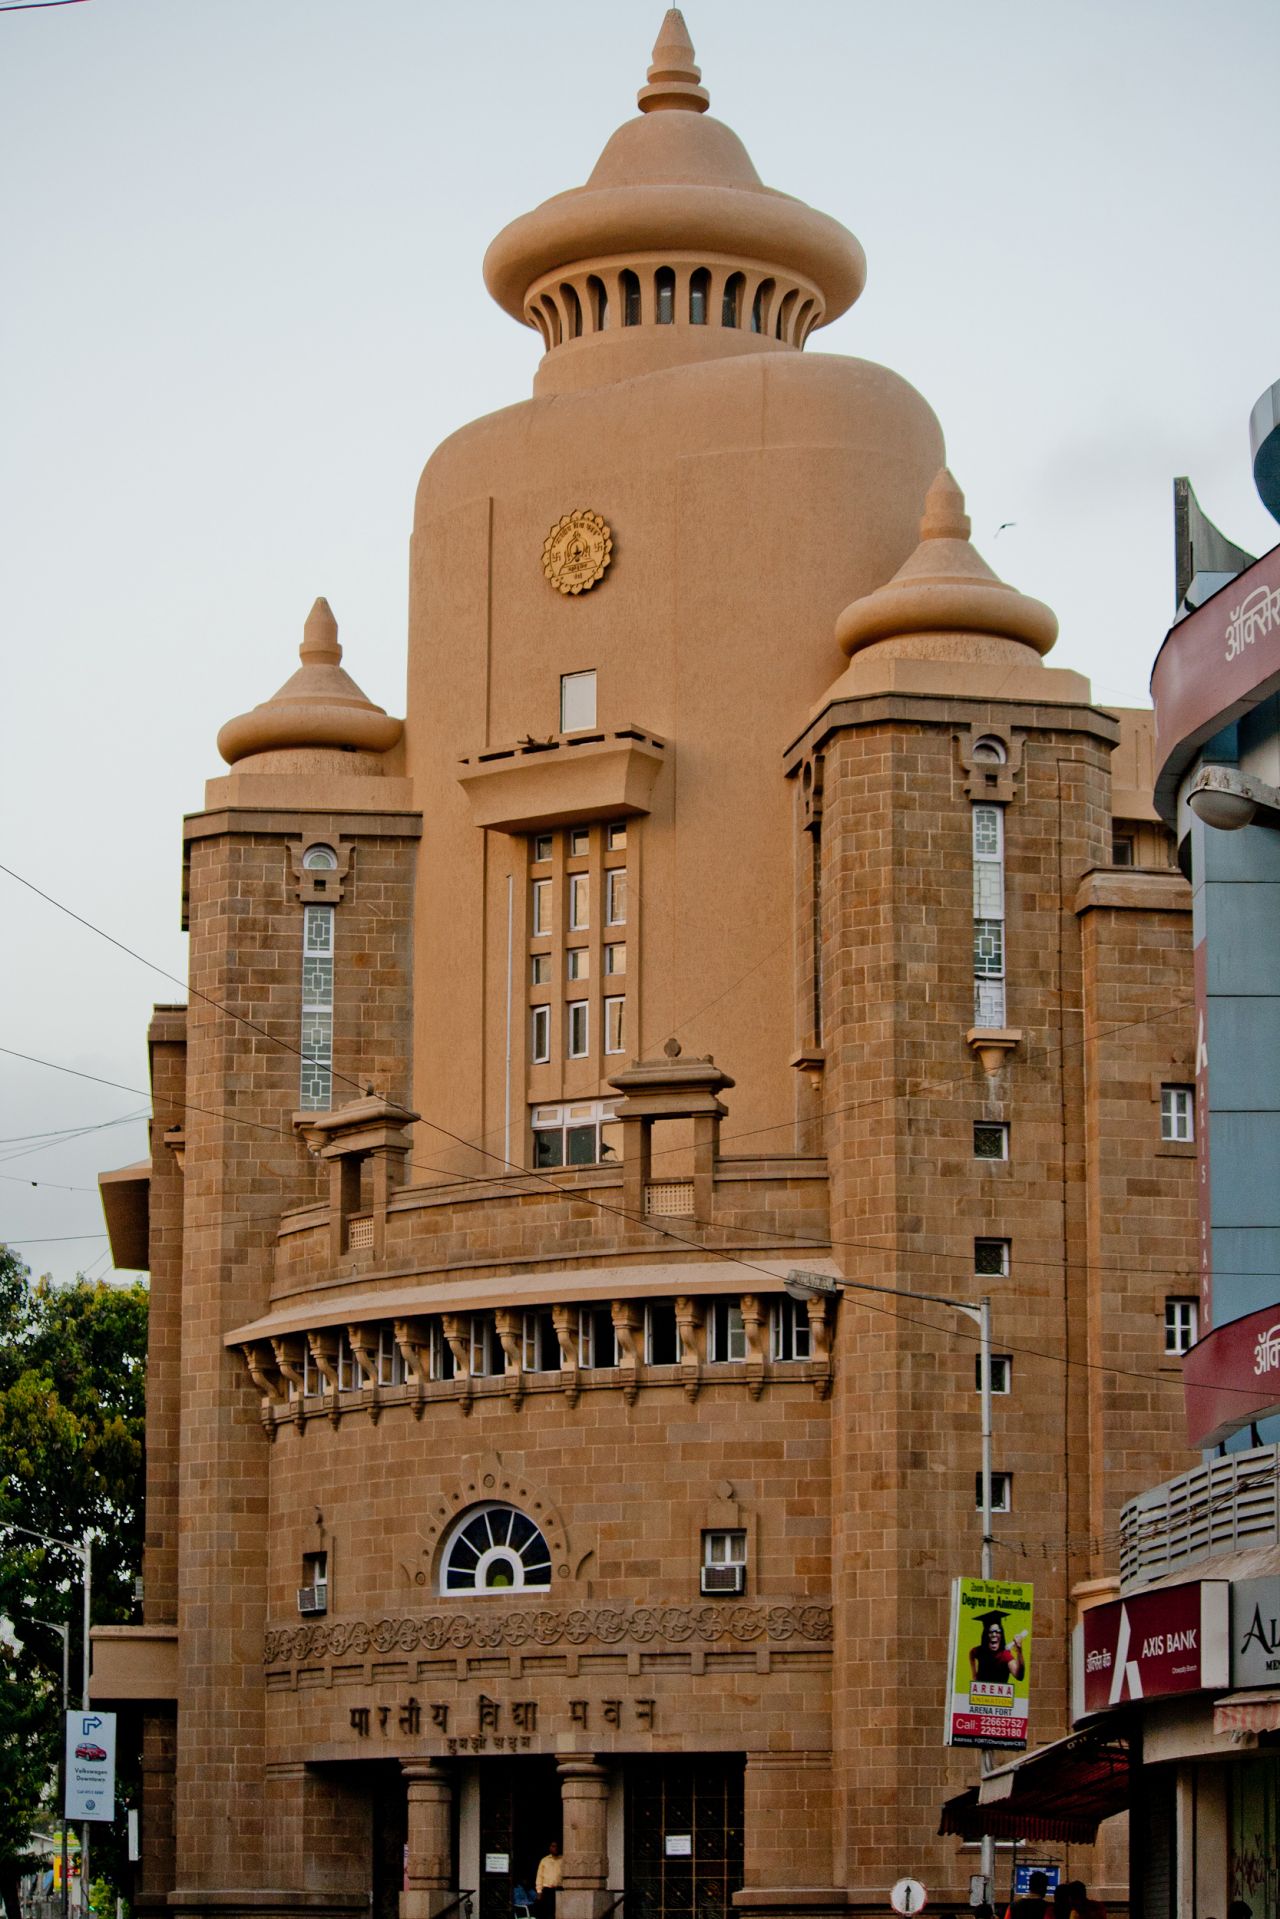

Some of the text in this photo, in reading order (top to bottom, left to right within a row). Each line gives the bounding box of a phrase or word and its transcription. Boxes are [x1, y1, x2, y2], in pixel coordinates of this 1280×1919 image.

[962, 1593, 1031, 1611] Degree in Animation
[1142, 1629, 1197, 1659] AXIS BANK
[972, 1684, 1012, 1695] ARENA
[969, 1706, 1012, 1716] ARENA FORT
[980, 1726, 1021, 1737] 22623180
[74, 1767, 108, 1775] Volkswagen
